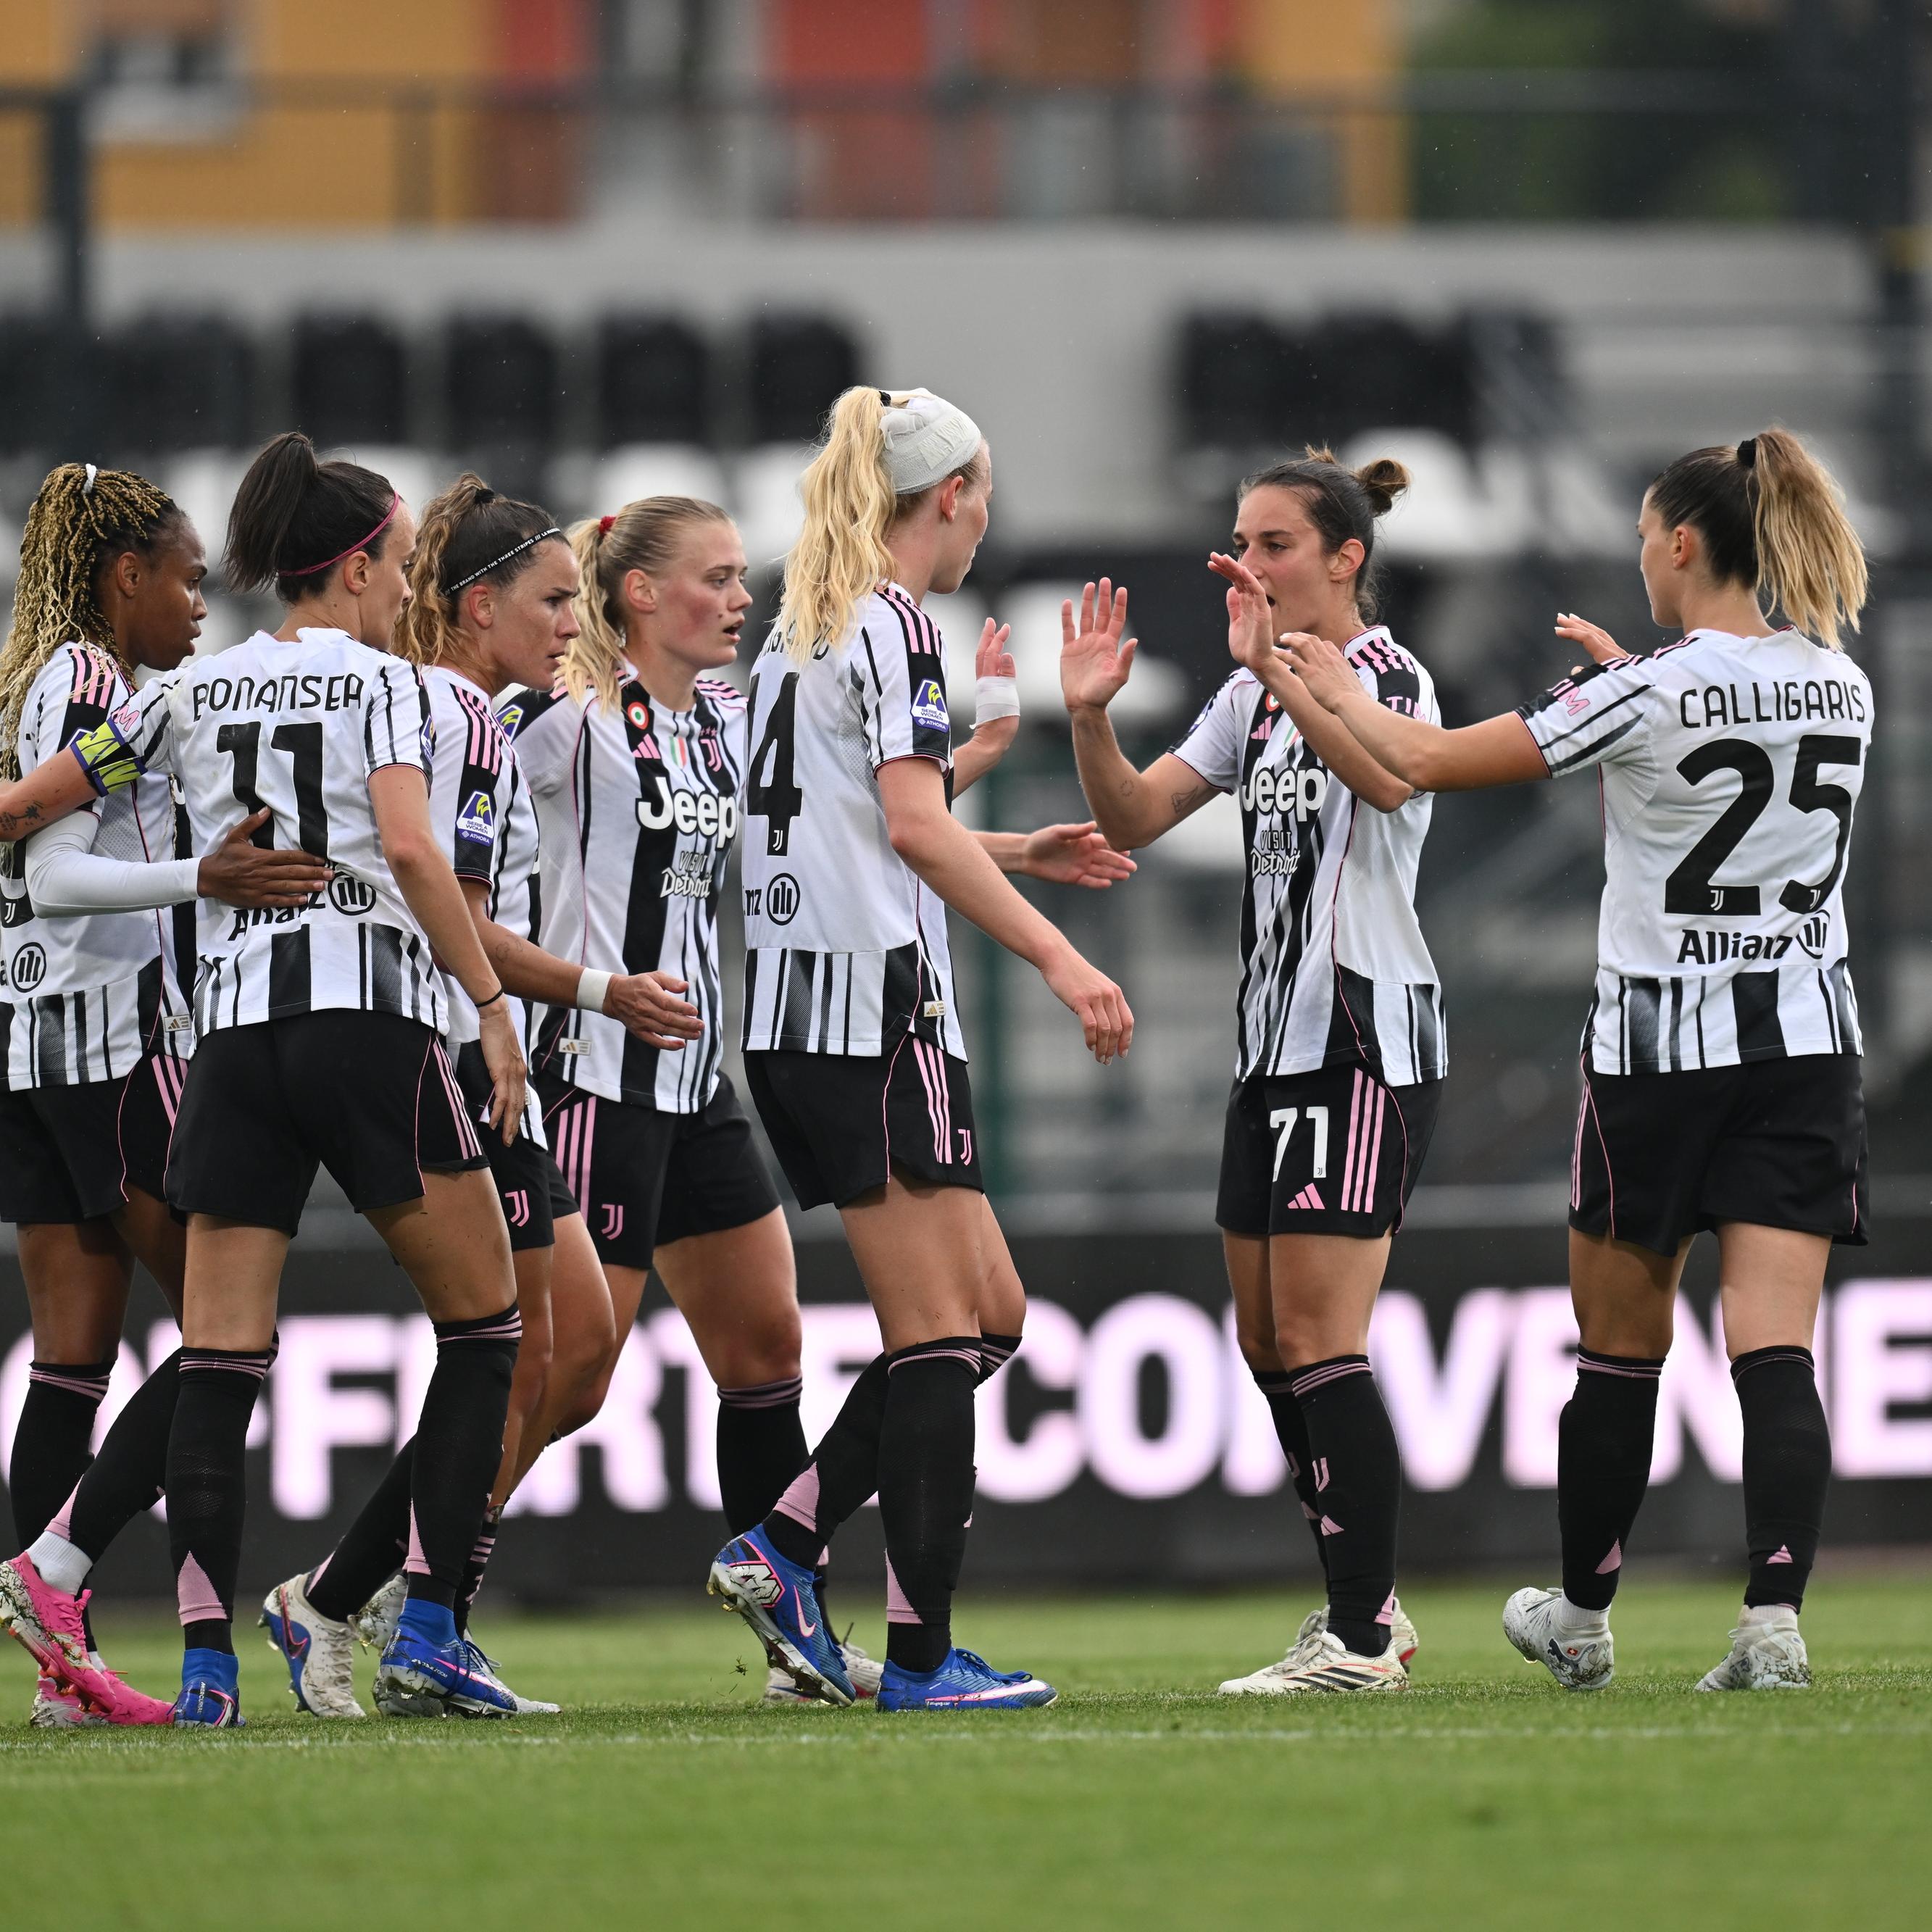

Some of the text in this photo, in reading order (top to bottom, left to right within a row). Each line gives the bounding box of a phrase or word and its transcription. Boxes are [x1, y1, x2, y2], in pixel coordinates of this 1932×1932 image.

[451, 583, 459, 592] THE
[459, 575, 475, 587] BRAND
[475, 567, 488, 577] WITH
[488, 560, 499, 569] THE
[498, 550, 515, 562] THREE
[515, 538, 535, 553] STRIPES
[1680, 680, 1865, 728] CALLIGARIS
[926, 720, 946, 730] ATHORA
[217, 721, 329, 860] 11
[1241, 757, 1328, 822] Jeep
[466, 825, 488, 834] WOMEN
[636, 775, 737, 849] Jeep
[1665, 734, 1862, 916] 25
[470, 833, 490, 844] ATHORA
[1260, 830, 1293, 851] VISIT
[678, 850, 709, 873] VISIT
[1250, 846, 1301, 879] Detroit
[659, 866, 713, 899] Detroit
[1270, 1106, 1329, 1183] 71
